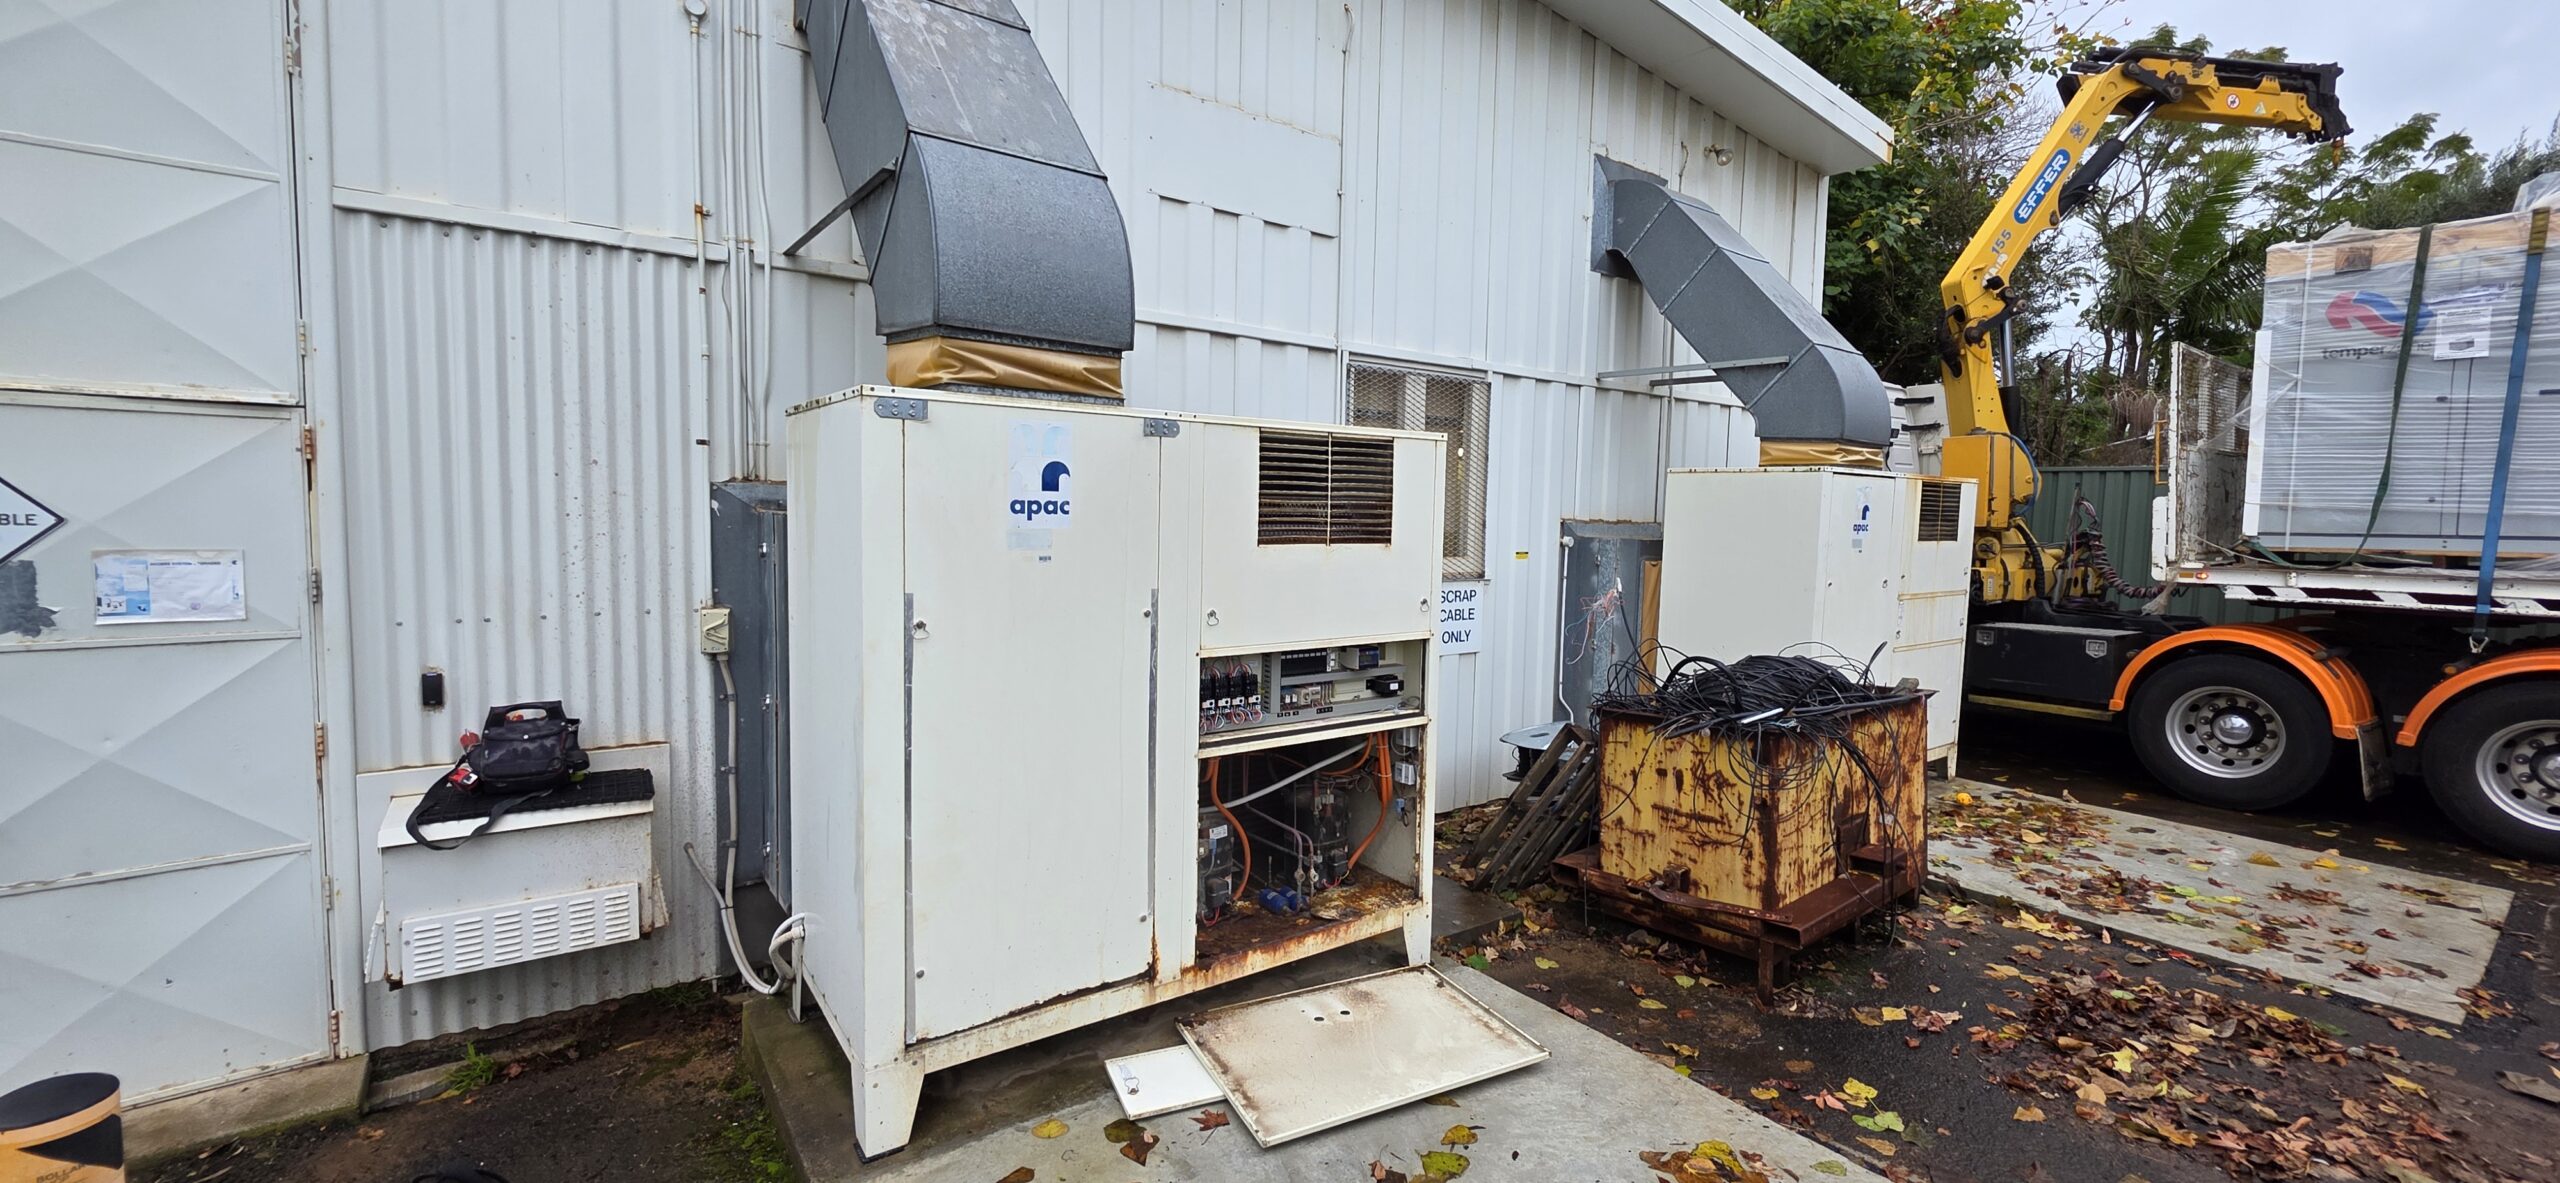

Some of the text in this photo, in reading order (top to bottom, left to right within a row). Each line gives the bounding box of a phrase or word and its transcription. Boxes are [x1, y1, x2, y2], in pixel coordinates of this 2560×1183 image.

[2018, 154, 2068, 220] EFFER
[1991, 229, 2012, 255] 155
[1009, 499, 1070, 521] apac
[1853, 523, 1869, 535] apac
[1441, 589, 1477, 604] SCRAP
[1440, 608, 1476, 623] CABLE
[1441, 629, 1472, 645] ONLY
